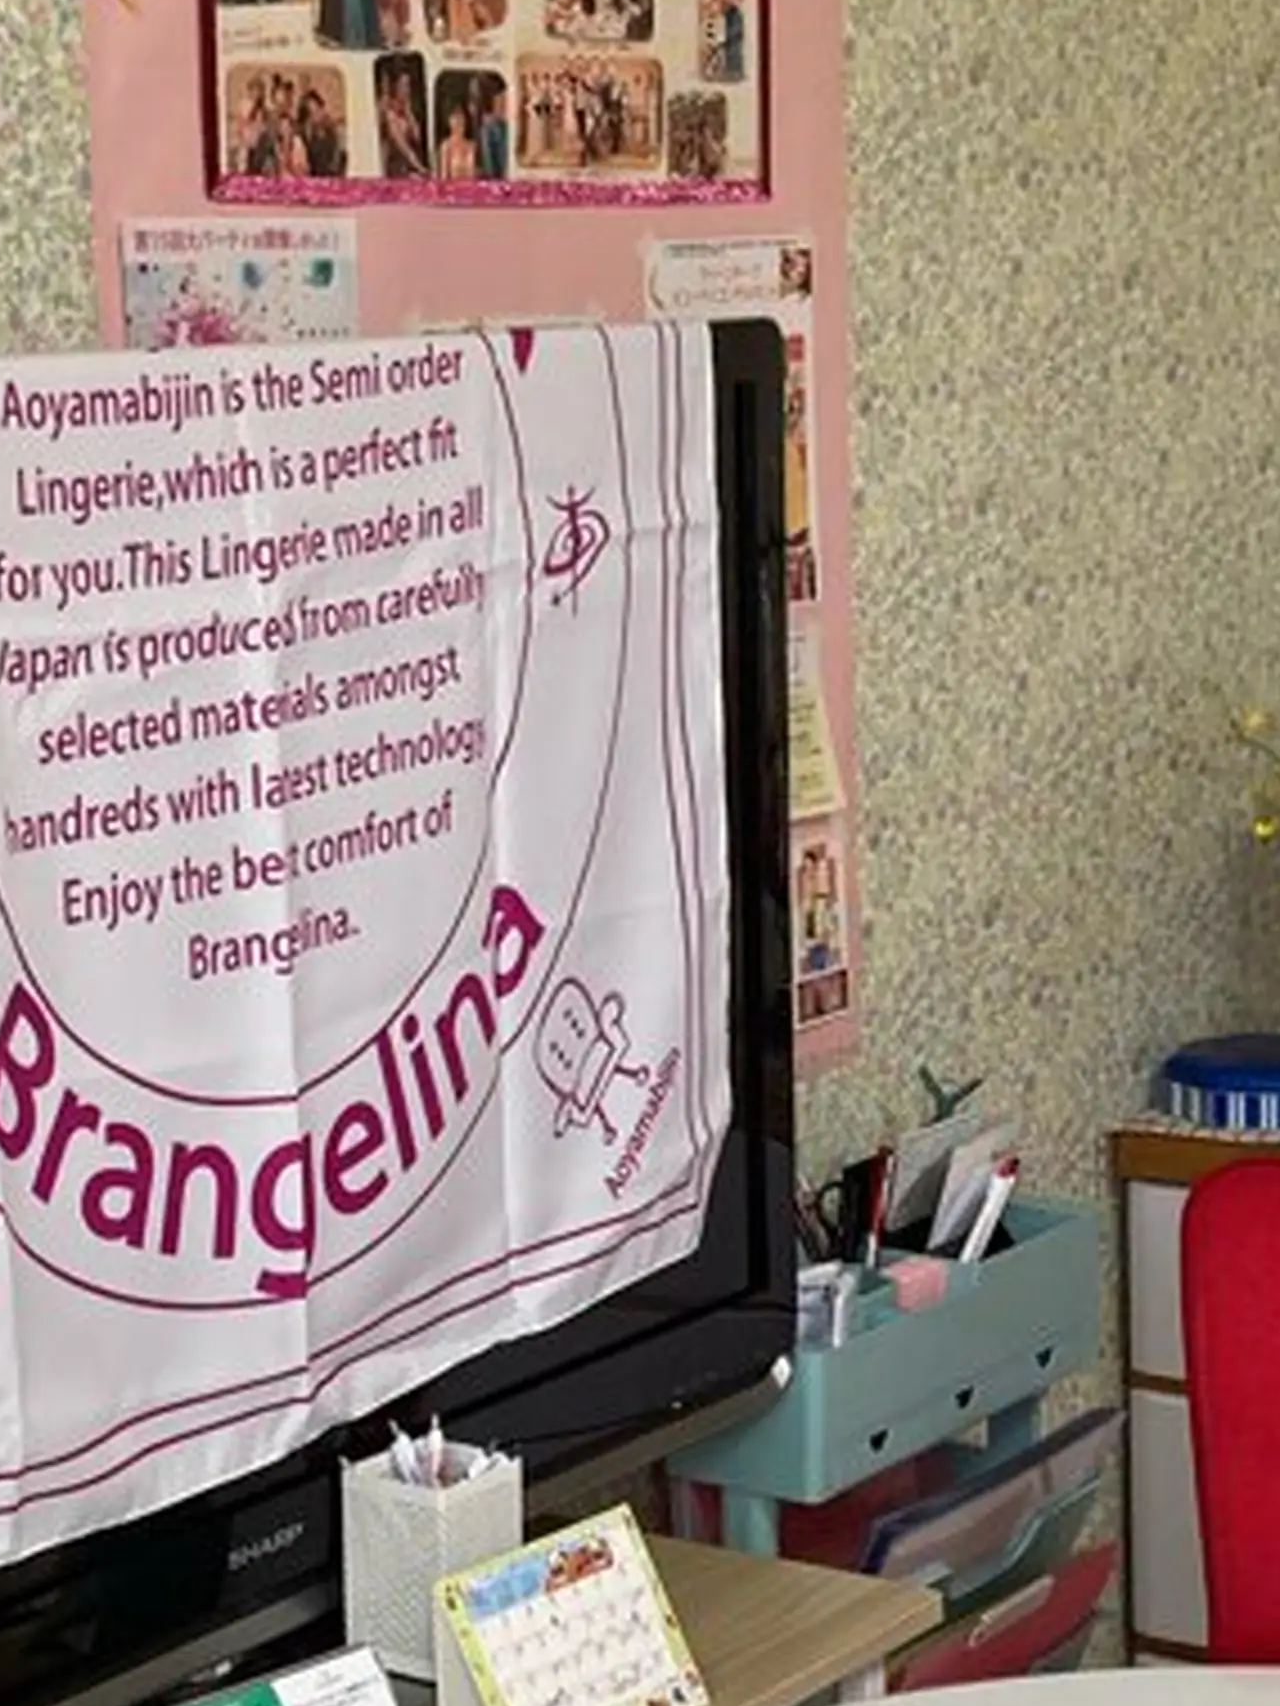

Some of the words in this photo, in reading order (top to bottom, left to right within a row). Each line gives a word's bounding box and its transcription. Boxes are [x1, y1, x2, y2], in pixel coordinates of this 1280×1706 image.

[0, 380, 215, 440] Aoyamabijin
[223, 369, 246, 414] is
[254, 362, 303, 412] the
[310, 354, 382, 407] Semi
[389, 348, 464, 395] order
[16, 448, 263, 525] Lingerie,which
[271, 443, 295, 486] is
[300, 450, 316, 484] a
[323, 427, 422, 497] perfect
[426, 417, 459, 461] fit
[200, 514, 327, 586] Lingerie
[334, 506, 413, 560] made
[418, 495, 446, 541] in
[449, 484, 485, 533] all
[103, 626, 131, 676] is
[138, 602, 299, 680] produced
[298, 595, 372, 648] from
[37, 706, 183, 767] selected
[191, 670, 330, 737] materials
[335, 645, 462, 711] amongst
[169, 767, 241, 830] with
[251, 752, 329, 812] latest
[60, 875, 164, 931] Enjoy
[171, 851, 222, 905] the
[232, 839, 300, 888] bet
[304, 805, 419, 880] comfort
[422, 787, 453, 834] of
[604, 1044, 684, 1201] Aoyamabijin
[226, 1521, 306, 1572] SHARP
